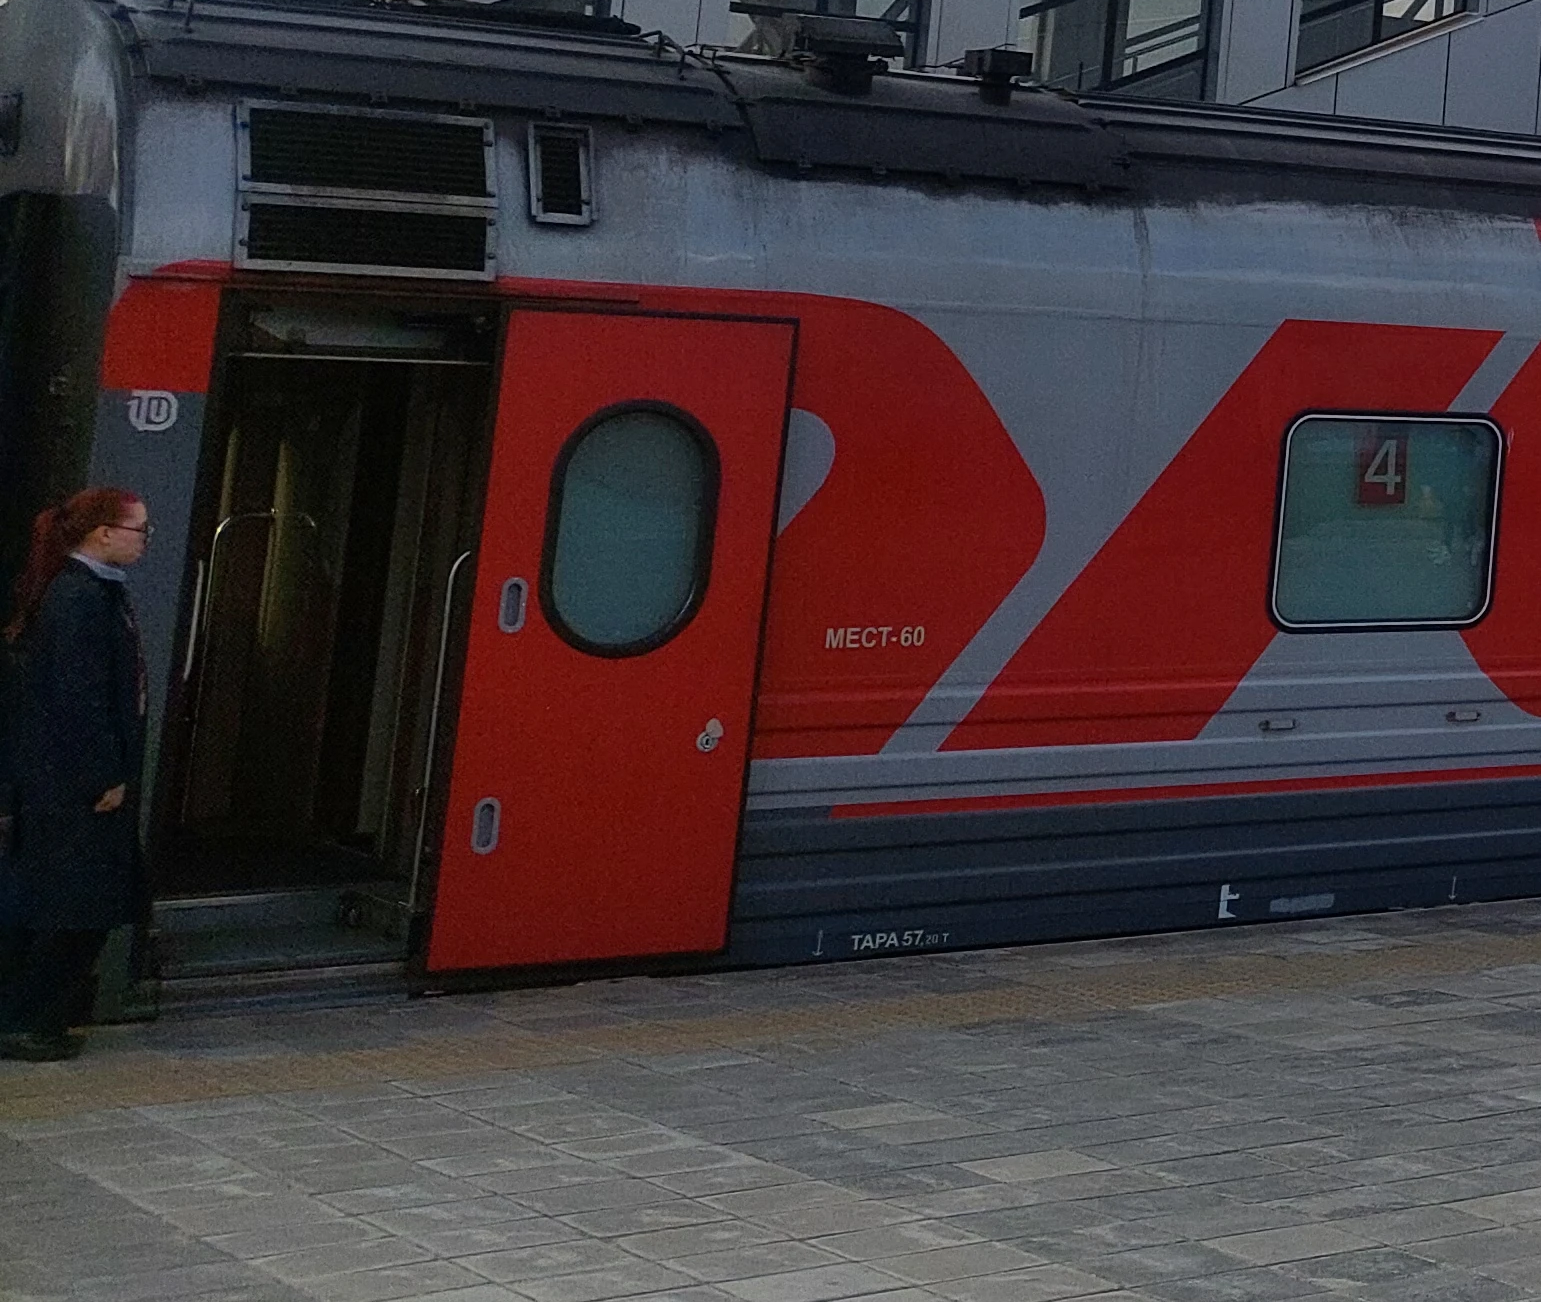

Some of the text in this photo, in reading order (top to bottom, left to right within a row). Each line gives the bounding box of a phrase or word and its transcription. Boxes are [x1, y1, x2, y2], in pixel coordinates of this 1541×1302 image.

[1364, 439, 1401, 495] 4
[825, 626, 925, 649] МЕСТ-60
[851, 931, 900, 951] ТАРА
